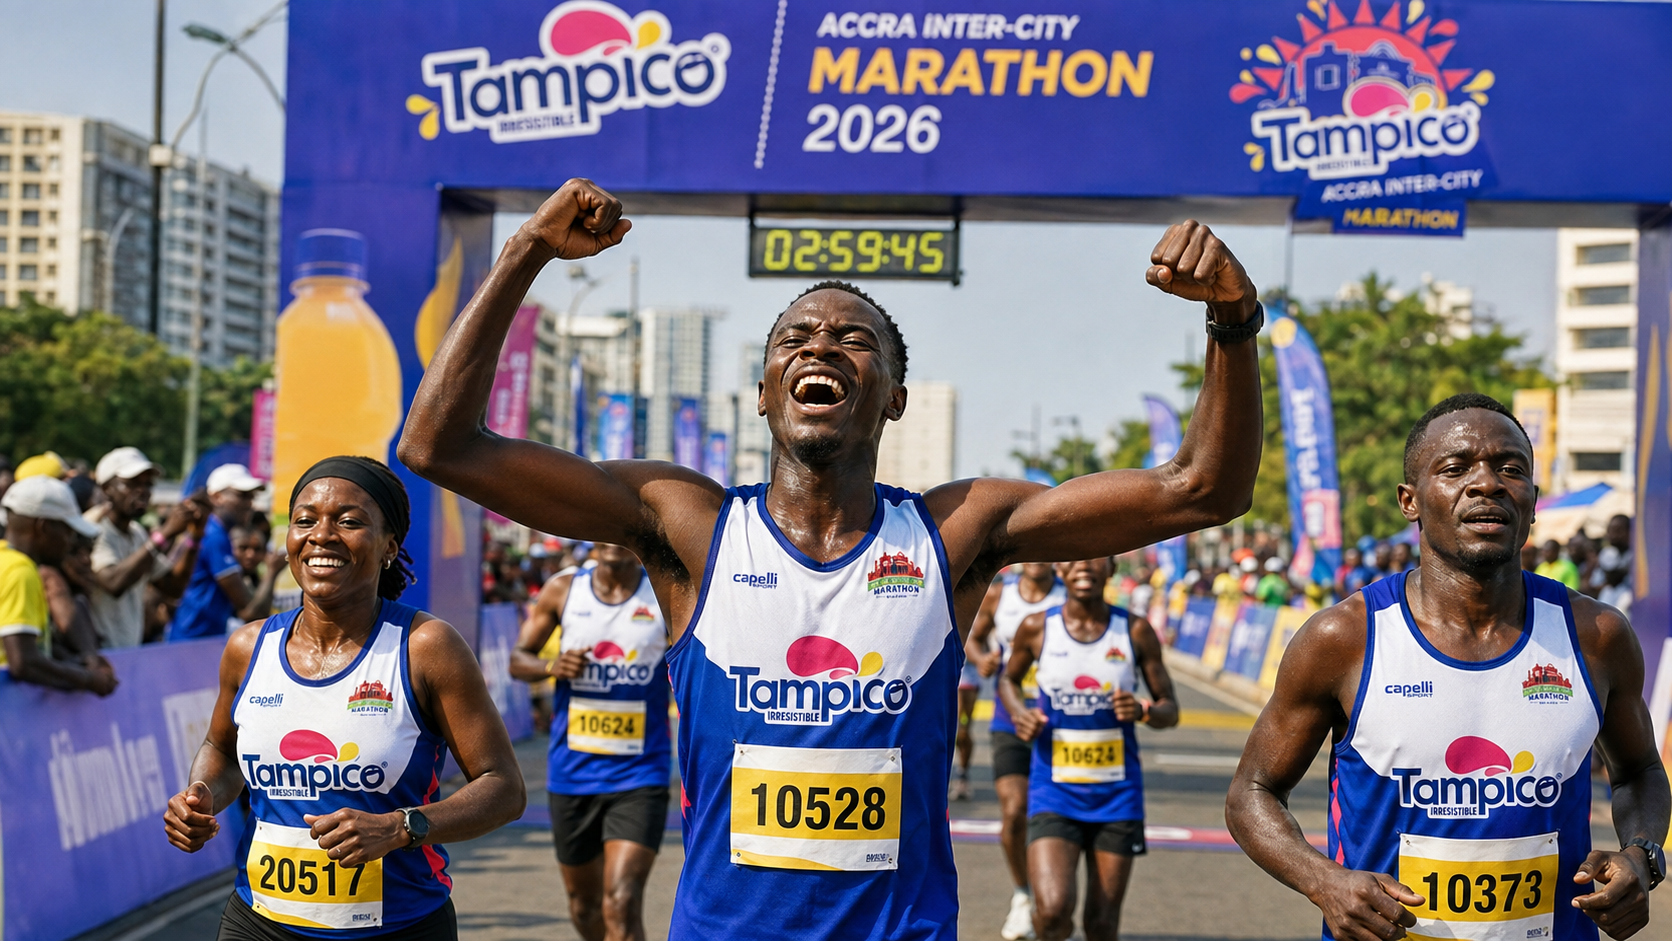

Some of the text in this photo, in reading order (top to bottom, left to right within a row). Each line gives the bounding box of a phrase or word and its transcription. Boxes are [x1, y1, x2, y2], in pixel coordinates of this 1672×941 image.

[816, 12, 1080, 40] ACCRA INTER-CITY
[434, 52, 716, 124] Tampico
[808, 47, 1154, 98] MARATHON
[802, 103, 942, 154] 2026
[1262, 115, 1469, 166] Tampico
[1321, 170, 1483, 203] ACCRA INTER-CITY
[1342, 208, 1459, 229] MARATHON
[763, 230, 944, 273] 02:59:45
[733, 572, 777, 586] capelli
[250, 693, 283, 706] capelli
[730, 666, 909, 723] Tampico
[1385, 681, 1432, 697] capelli
[580, 715, 634, 735] 10624
[768, 711, 819, 723] IRRESISTIBLE
[242, 754, 385, 797] Tampico
[1063, 746, 1115, 764] 10624
[751, 783, 886, 831] 10528
[1392, 768, 1560, 815] Tampico
[1431, 807, 1477, 816] IRRESISTIBLE
[260, 855, 364, 896] 20517
[1423, 870, 1543, 913] 10373
